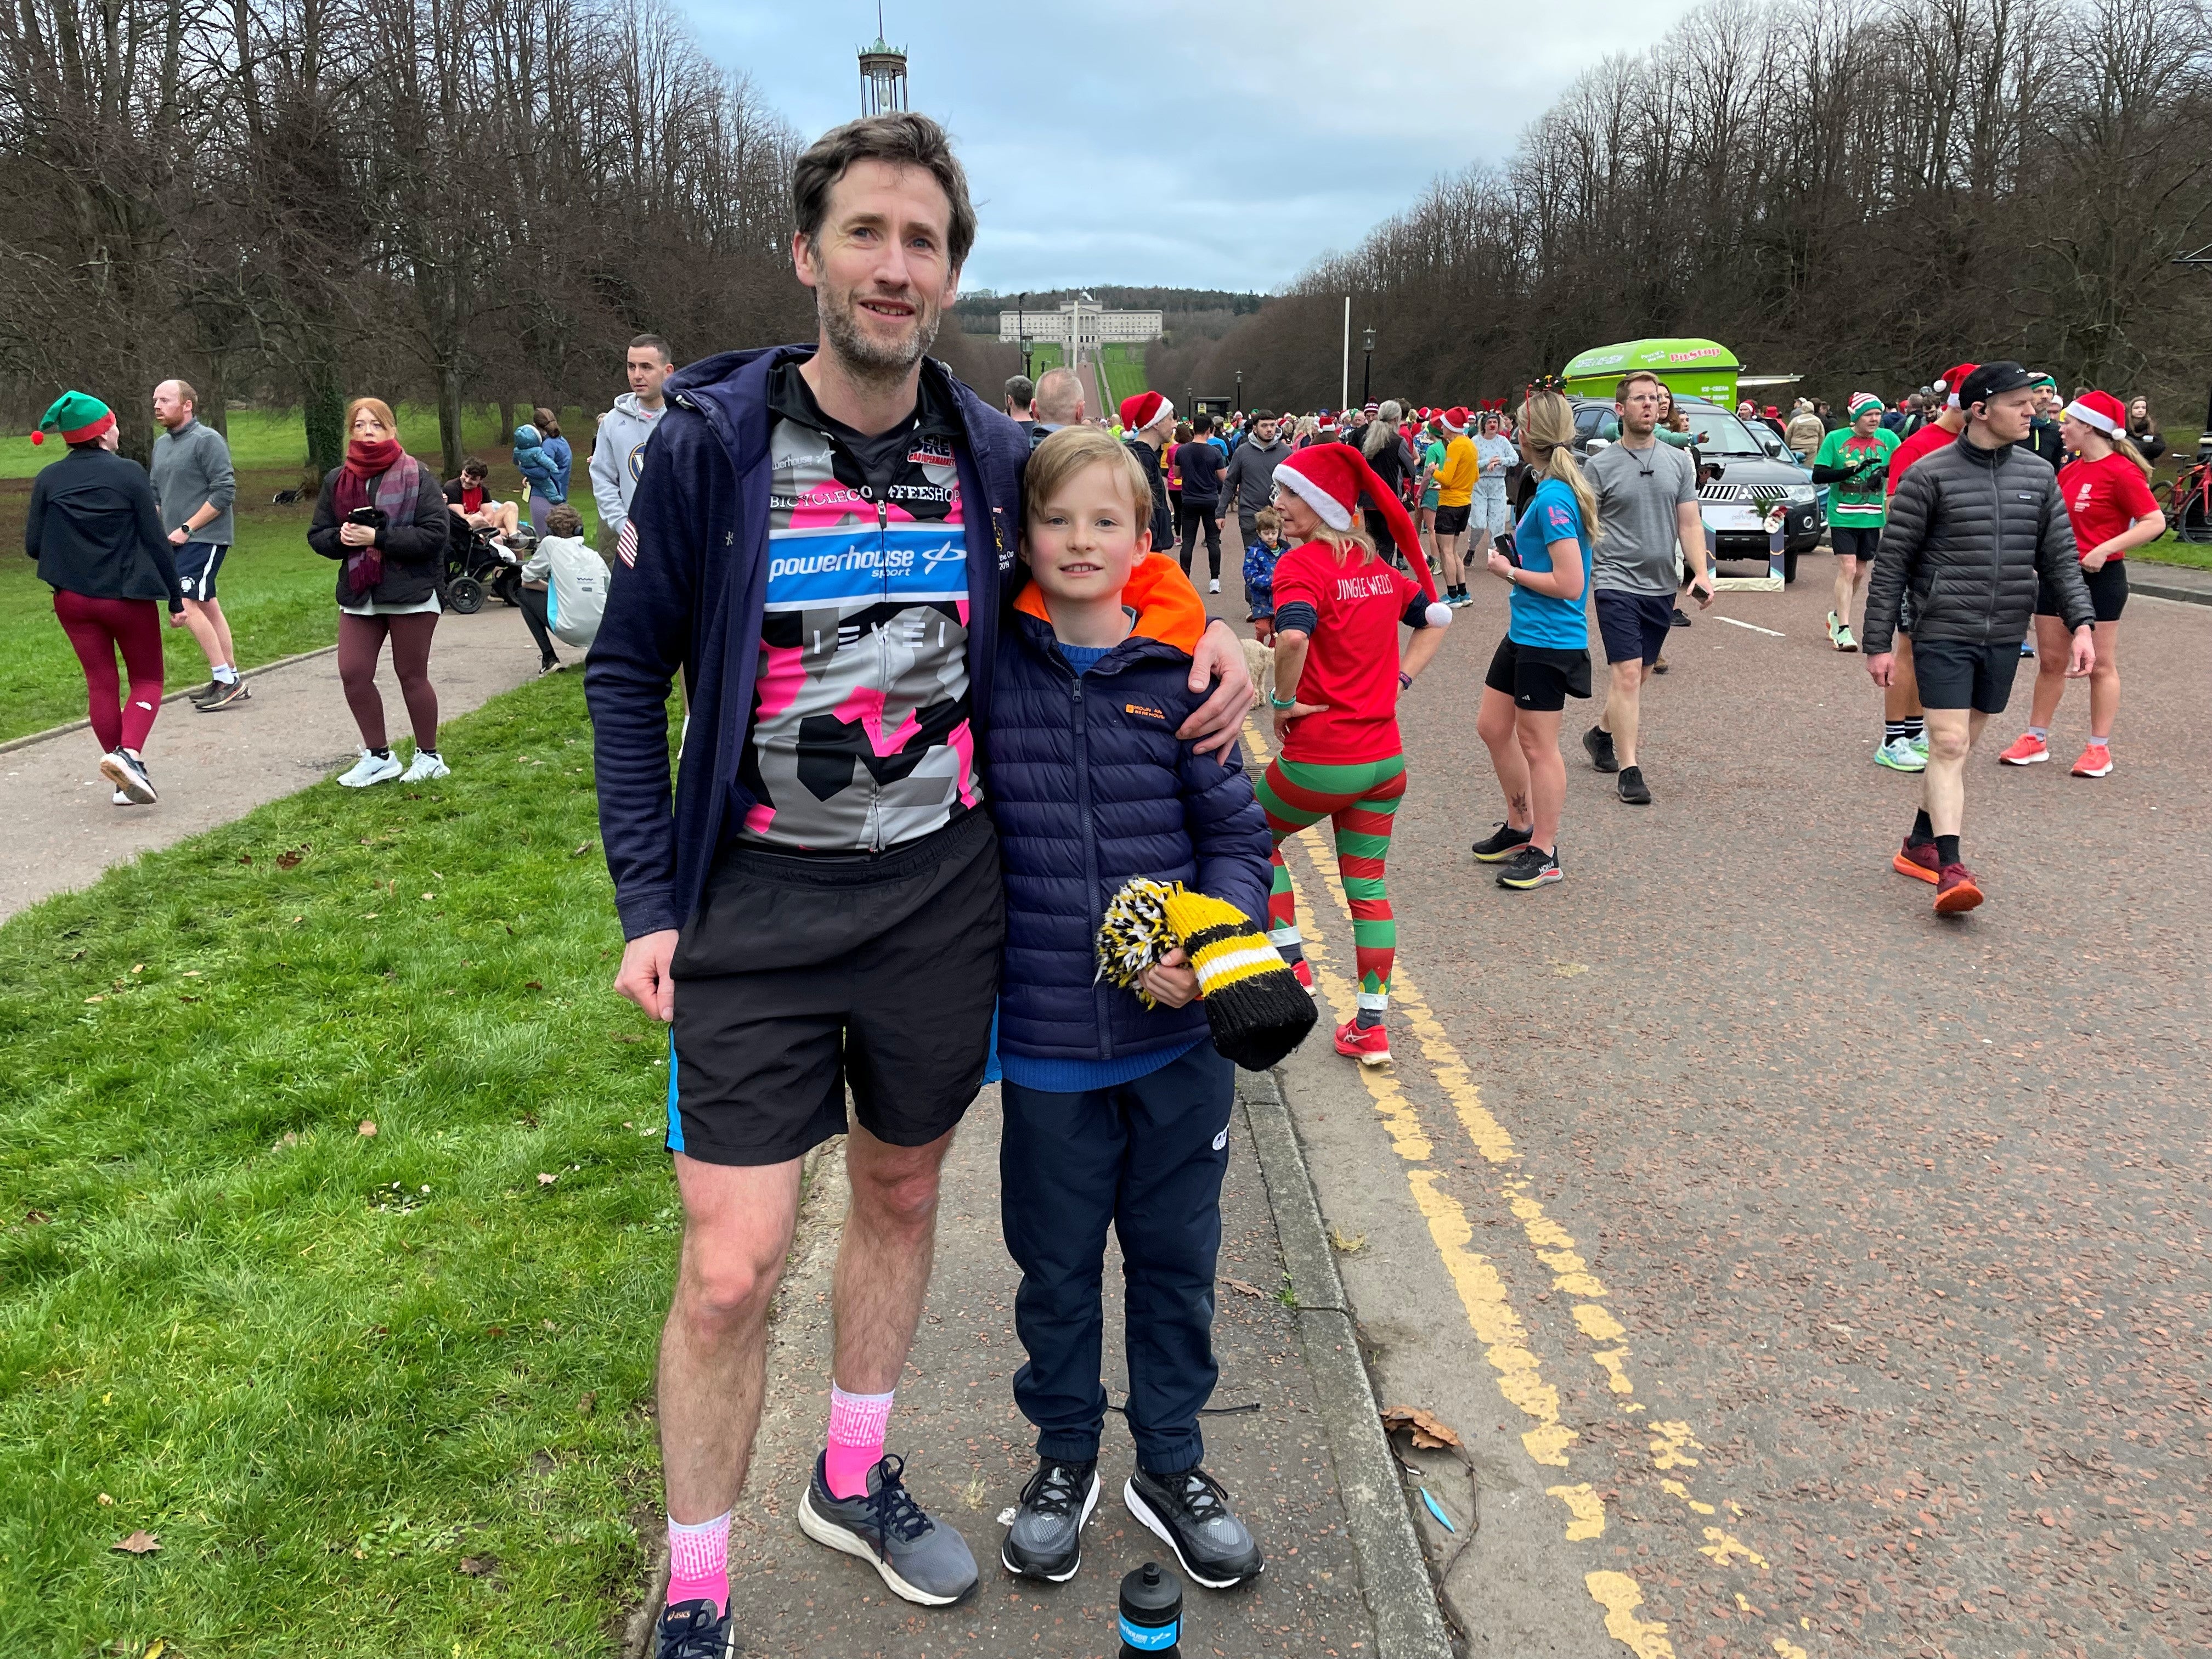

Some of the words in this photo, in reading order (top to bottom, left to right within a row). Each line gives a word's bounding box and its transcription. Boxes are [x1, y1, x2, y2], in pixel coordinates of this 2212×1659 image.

[772, 455, 812, 470] werhouse
[768, 545, 915, 583] powerhouse
[871, 567, 911, 578] sport
[1336, 577, 1369, 601] JINGLE
